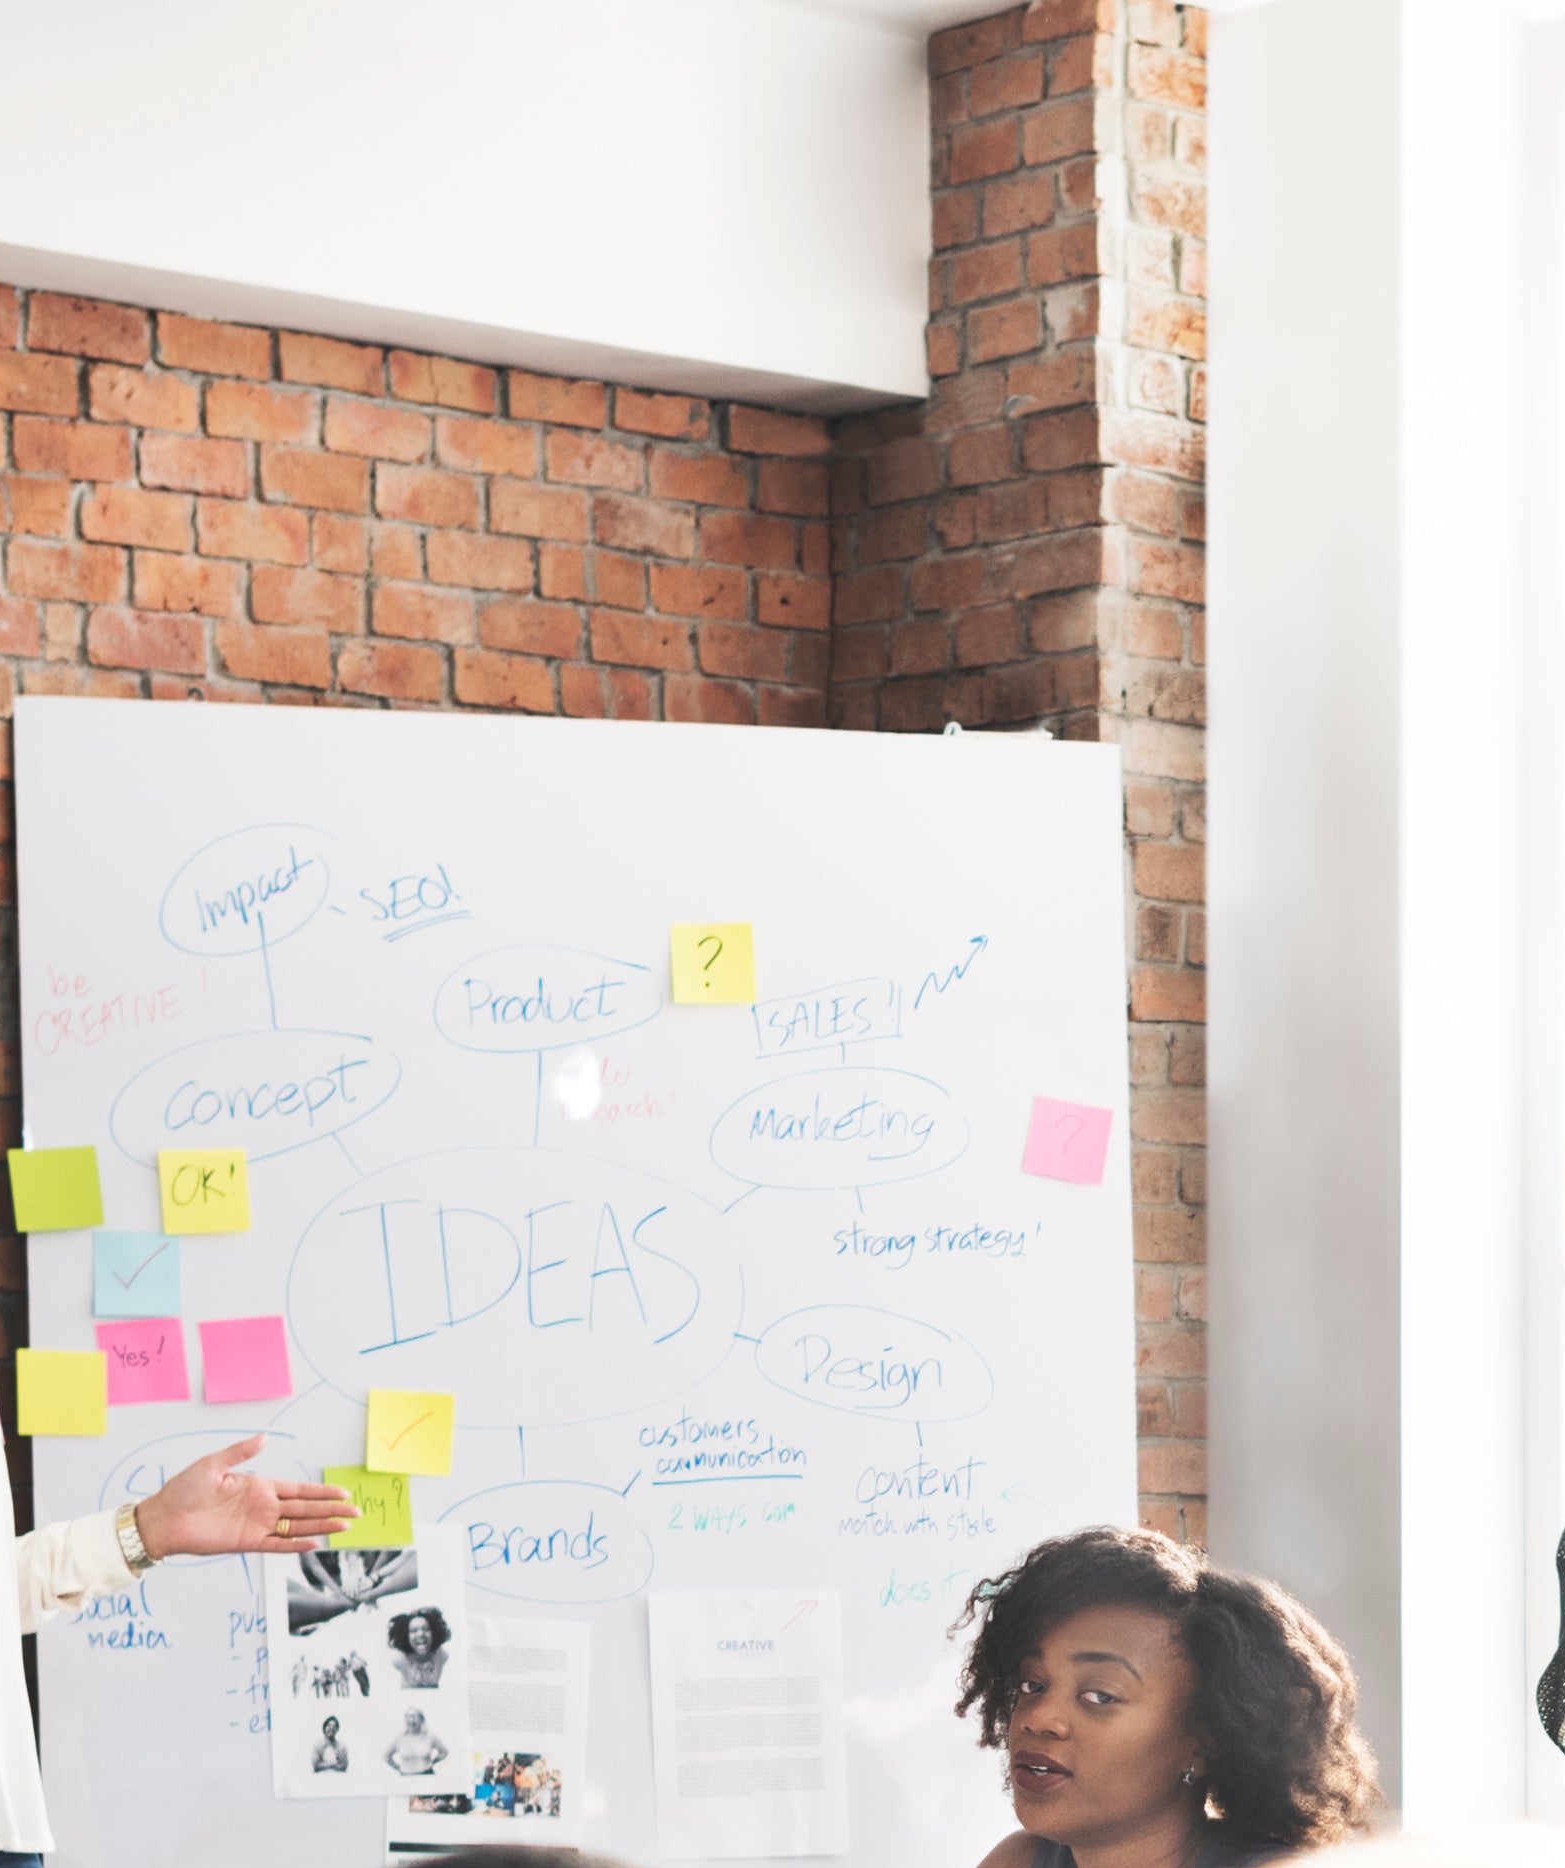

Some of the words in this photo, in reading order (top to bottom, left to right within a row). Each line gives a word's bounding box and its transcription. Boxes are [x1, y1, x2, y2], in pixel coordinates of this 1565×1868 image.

[195, 845, 314, 932] Impact
[360, 864, 461, 921] SEO!
[45, 961, 93, 998] be
[697, 935, 724, 990] ?
[464, 973, 627, 1027] Product
[749, 1092, 936, 1161] Marketing
[171, 1162, 237, 1207] OK!
[834, 1220, 917, 1270] strong
[340, 1200, 701, 1353] IDEAS
[796, 1333, 943, 1409] Design
[639, 1405, 760, 1447] customers
[656, 1435, 807, 1475] communication
[354, 1476, 403, 1527] hy?
[668, 1504, 684, 1530] 2
[839, 1504, 898, 1536] match
[468, 1510, 608, 1571] Brands
[879, 1567, 932, 1607] does
[717, 1639, 775, 1652] CREATIVE
